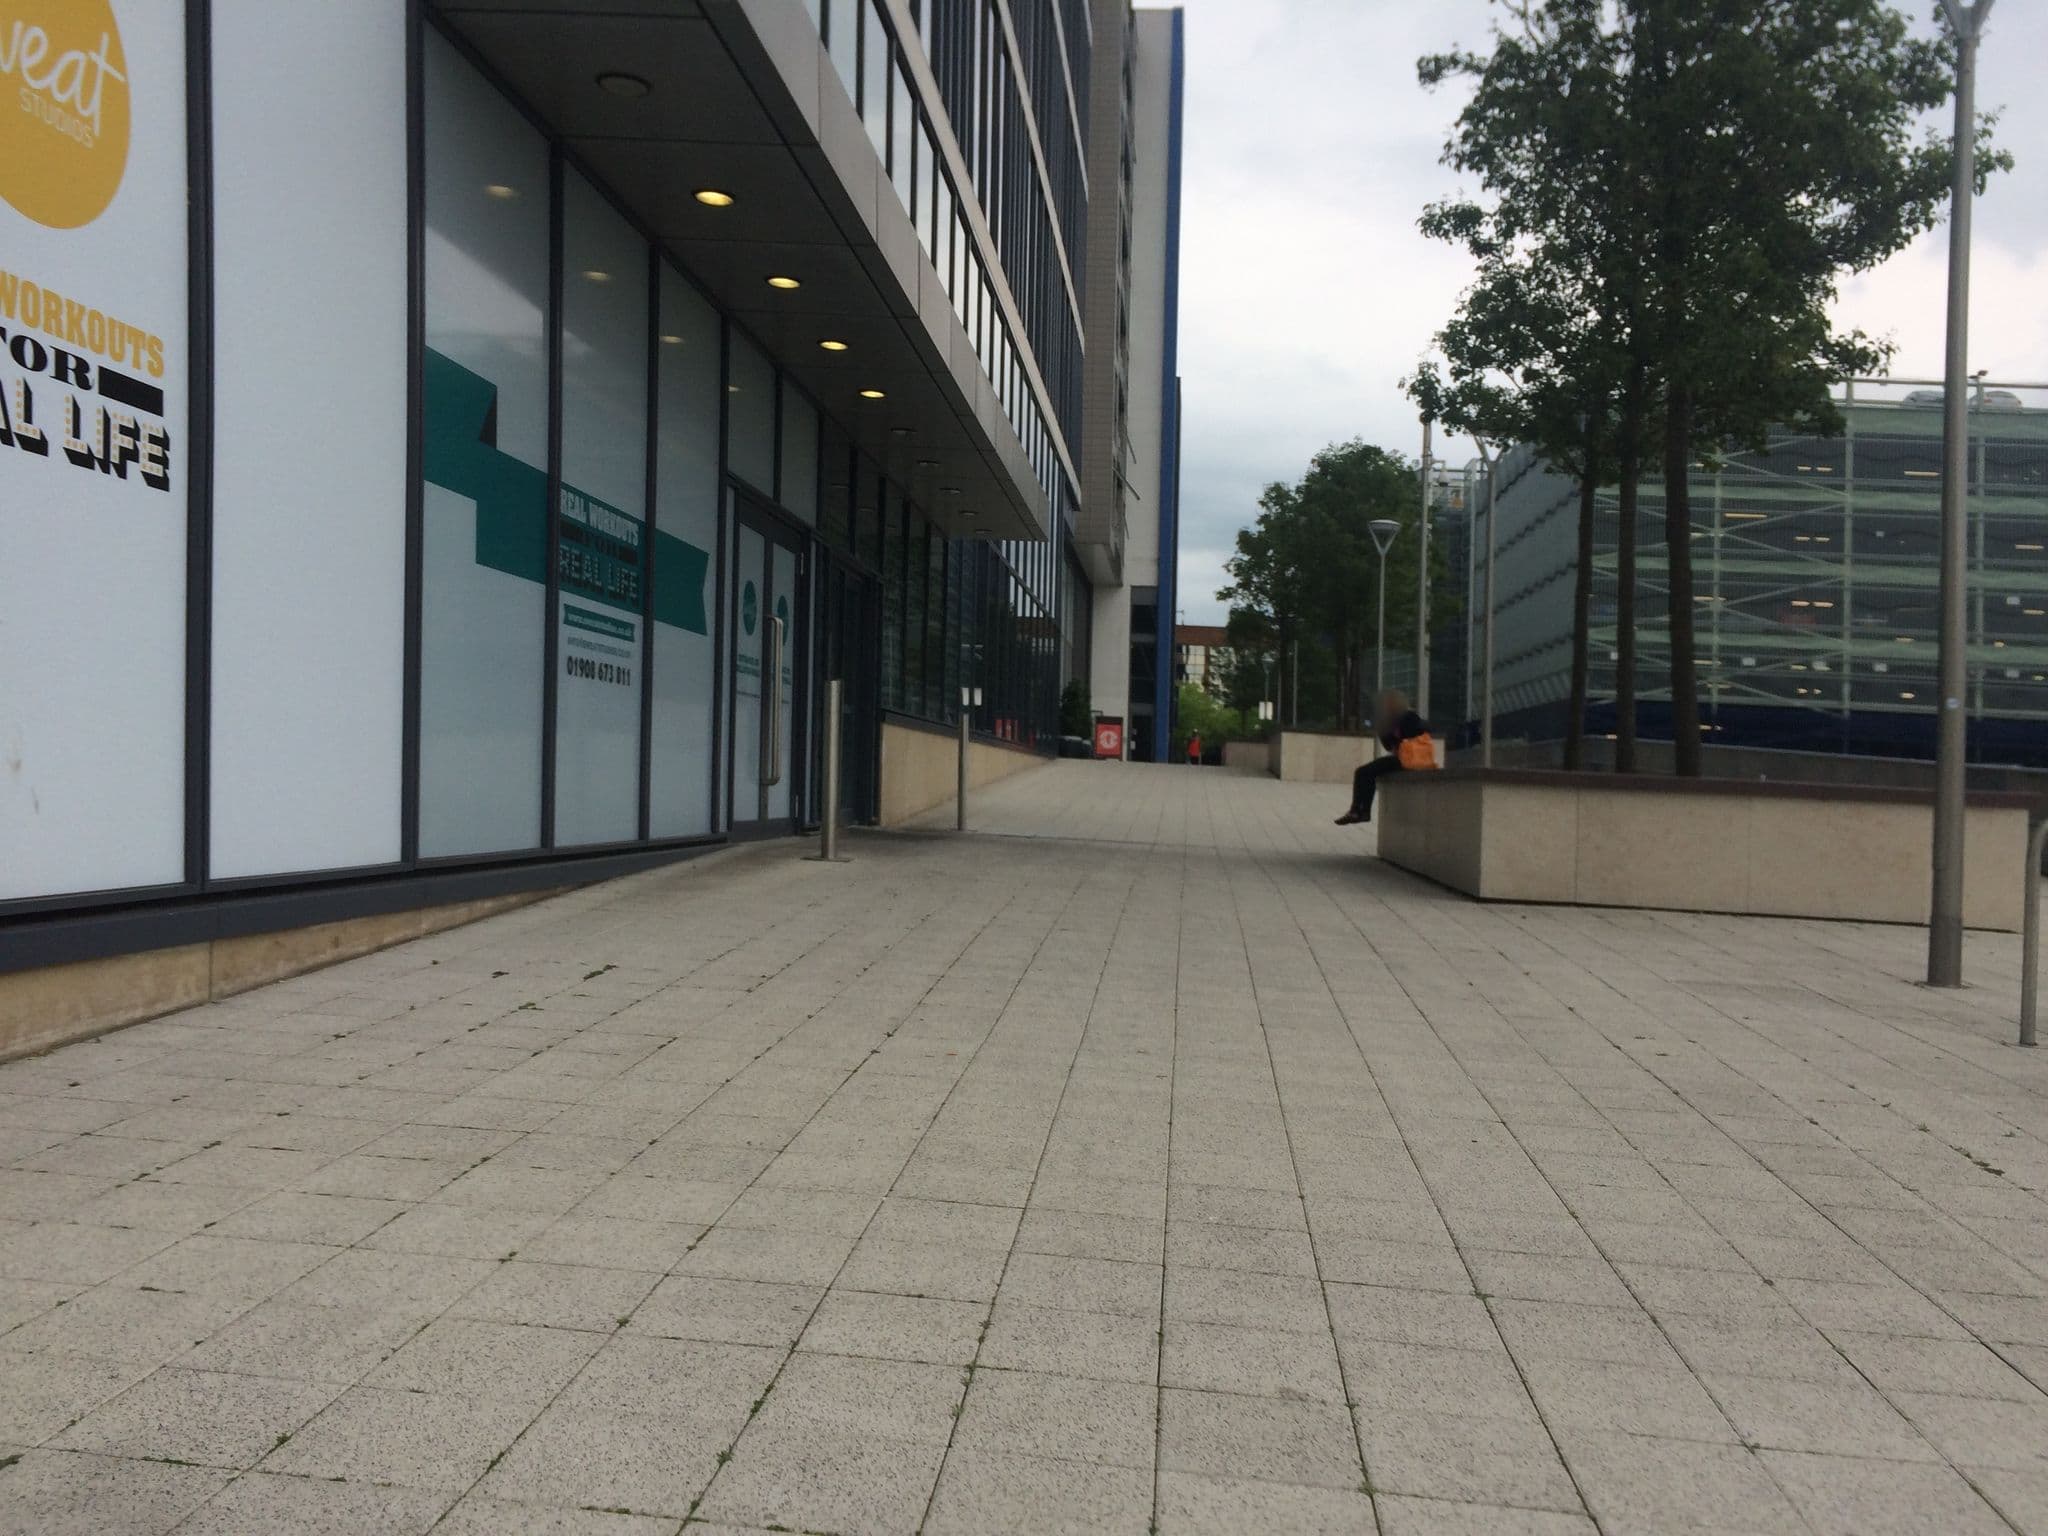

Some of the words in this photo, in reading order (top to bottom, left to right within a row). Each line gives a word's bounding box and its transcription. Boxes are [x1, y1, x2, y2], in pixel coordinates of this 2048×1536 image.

[19, 87, 93, 148] STUDIOS
[0, 326, 94, 390] OR
[63, 395, 170, 492] LIFE
[560, 488, 586, 523] REAL
[589, 501, 639, 546] WORKOUTS
[560, 544, 602, 590] REAL
[606, 560, 639, 607] LIFE
[567, 656, 595, 680] 01908
[598, 662, 614, 684] 673
